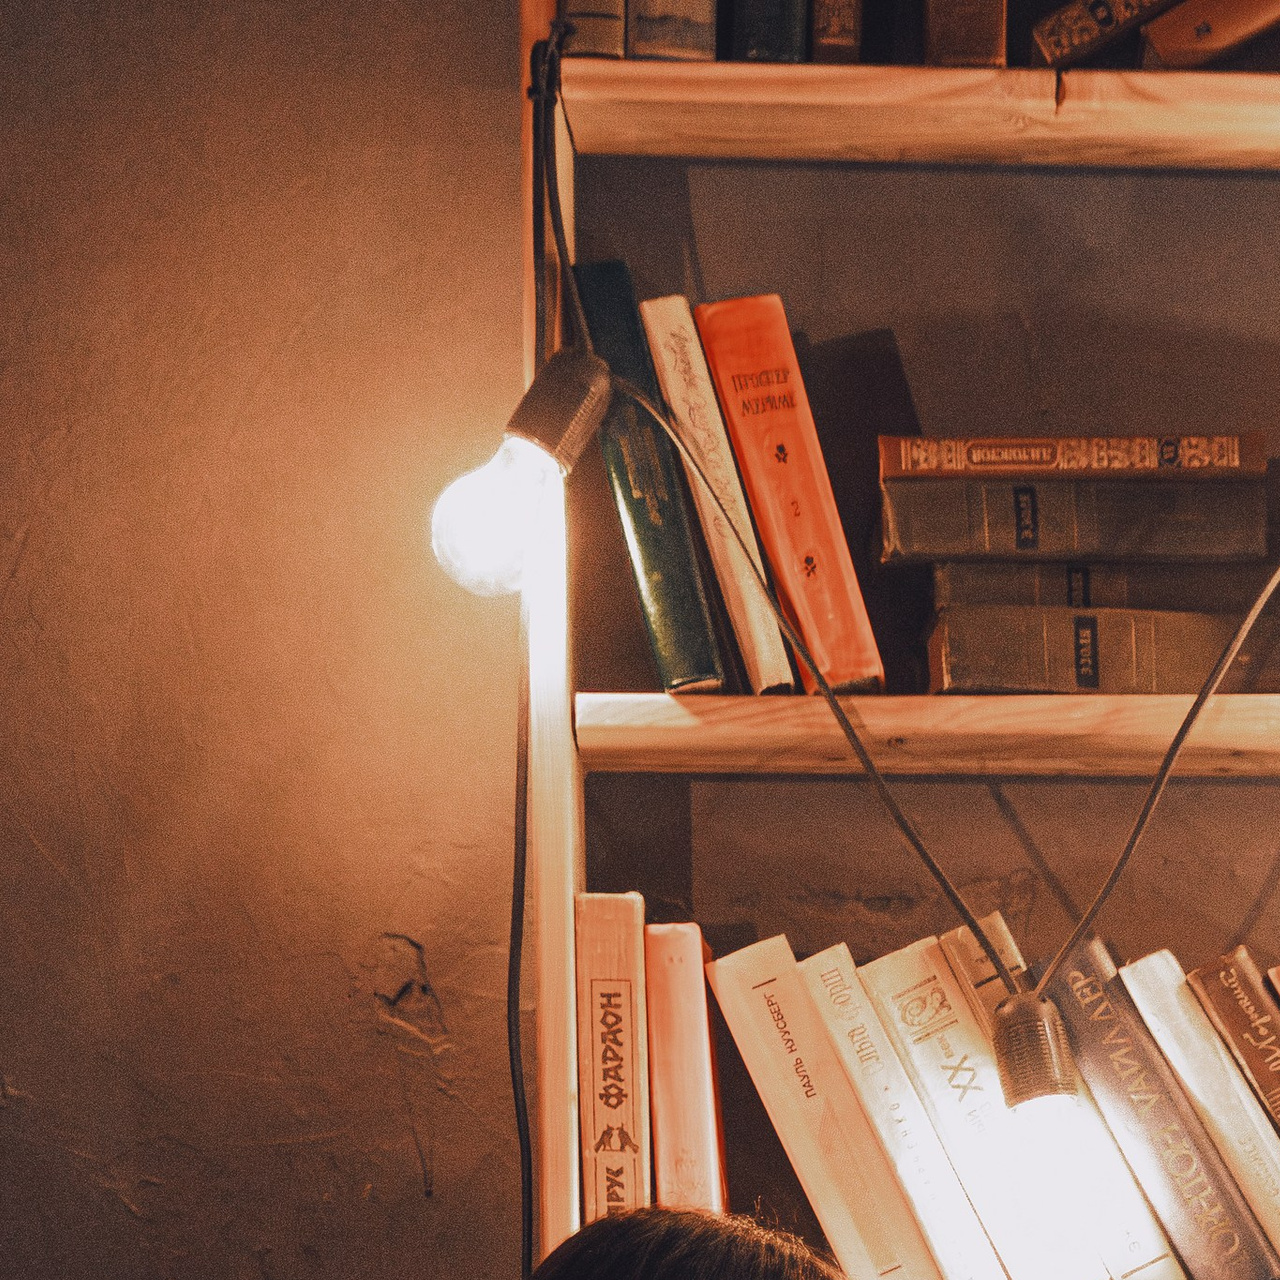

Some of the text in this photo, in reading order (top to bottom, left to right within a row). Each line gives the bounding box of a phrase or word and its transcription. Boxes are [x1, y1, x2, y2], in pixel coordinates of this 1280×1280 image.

[790, 500, 802, 518] 2
[599, 992, 626, 1110] ФАРАОН
[762, 989, 817, 1099] ПАУЛЬ КУУСБЕРГ
[934, 1032, 954, 1060] век
